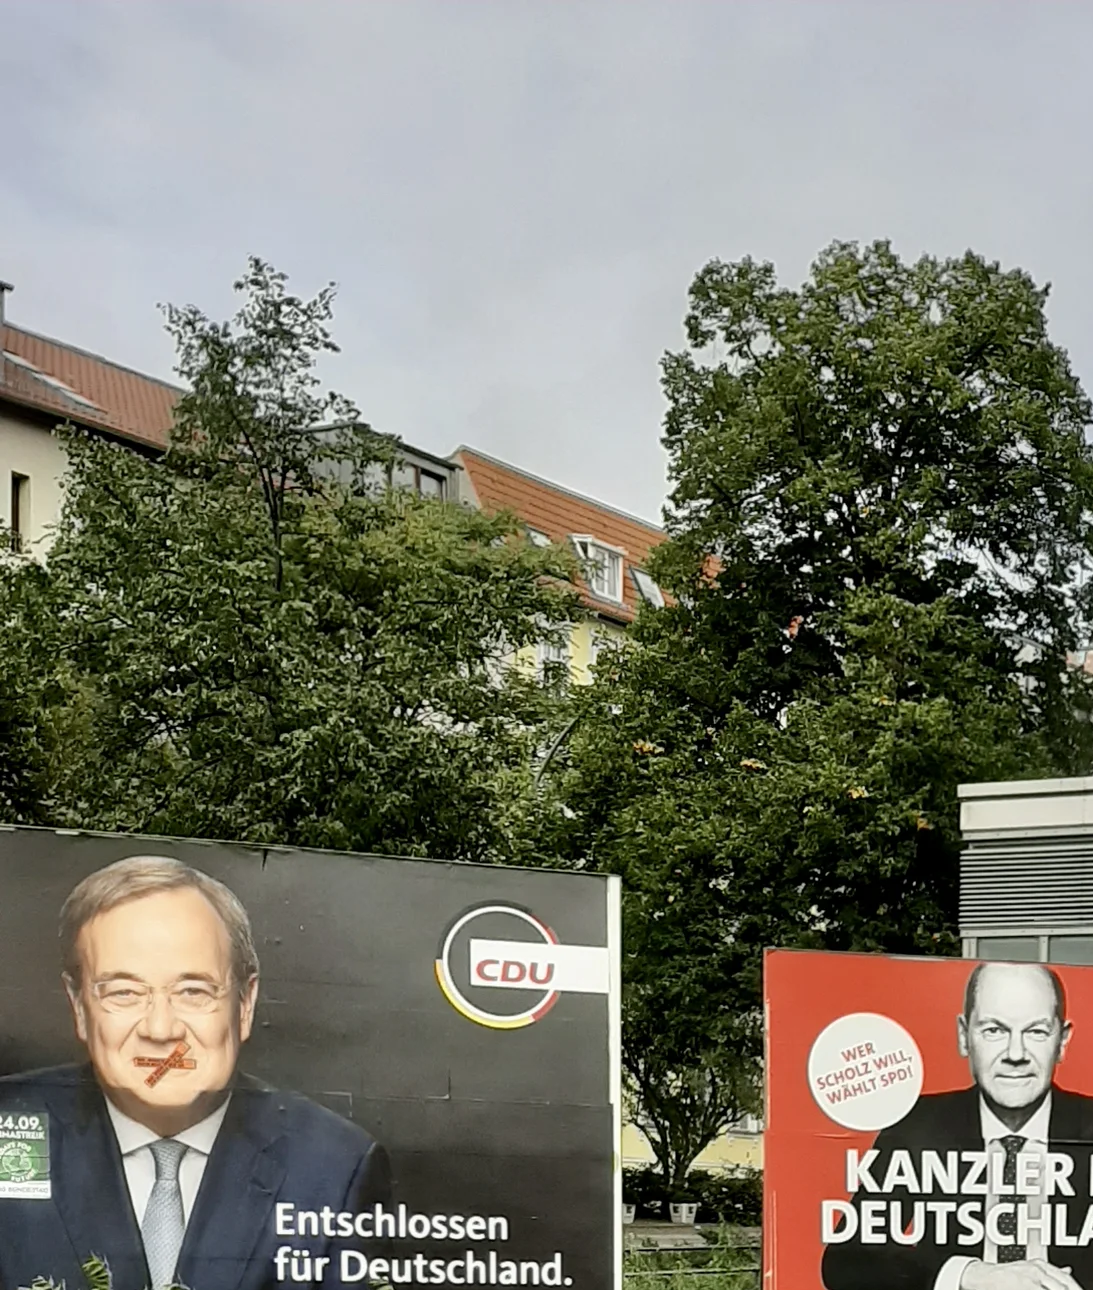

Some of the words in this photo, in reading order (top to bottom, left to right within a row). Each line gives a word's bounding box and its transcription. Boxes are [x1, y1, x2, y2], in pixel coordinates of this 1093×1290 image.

[475, 958, 555, 985] CDU
[816, 1060, 872, 1090] SCHOLZ
[873, 1049, 913, 1071] WILL,
[840, 1041, 876, 1063] WER
[826, 1077, 877, 1104] WÄHLT
[880, 1065, 914, 1087] SPD!
[845, 1149, 1076, 1197] KANZLER
[274, 1202, 510, 1242] Entschlossen
[274, 1248, 326, 1284] für
[340, 1251, 574, 1288] Deutschland.
